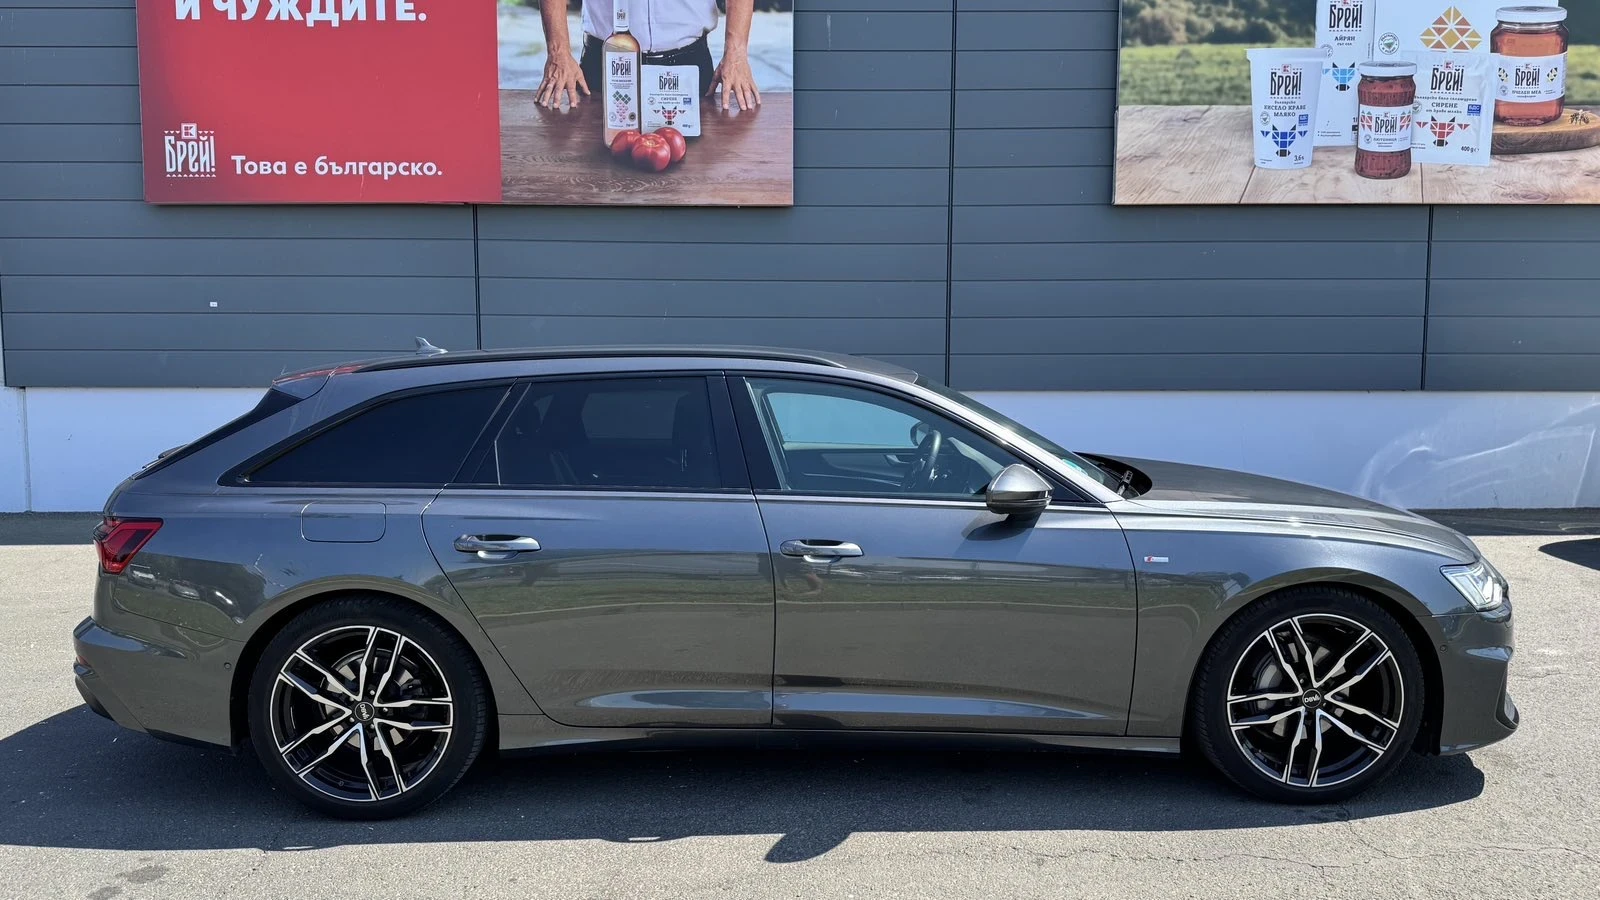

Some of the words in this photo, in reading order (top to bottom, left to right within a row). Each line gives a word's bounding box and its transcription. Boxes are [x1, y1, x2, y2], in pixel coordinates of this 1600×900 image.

[213, 0, 427, 27] ЧУЖДИТЕ.
[1329, 4, 1362, 28] Брей!
[659, 75, 679, 90] Брей!
[1270, 71, 1302, 95] Брей!
[1430, 68, 1464, 91] Брей!
[1515, 68, 1540, 86] Брей!
[1374, 116, 1397, 133] Брей!
[164, 135, 216, 173] Брей!
[231, 155, 287, 175] Това
[294, 161, 307, 175] е
[314, 156, 443, 180] българско.
